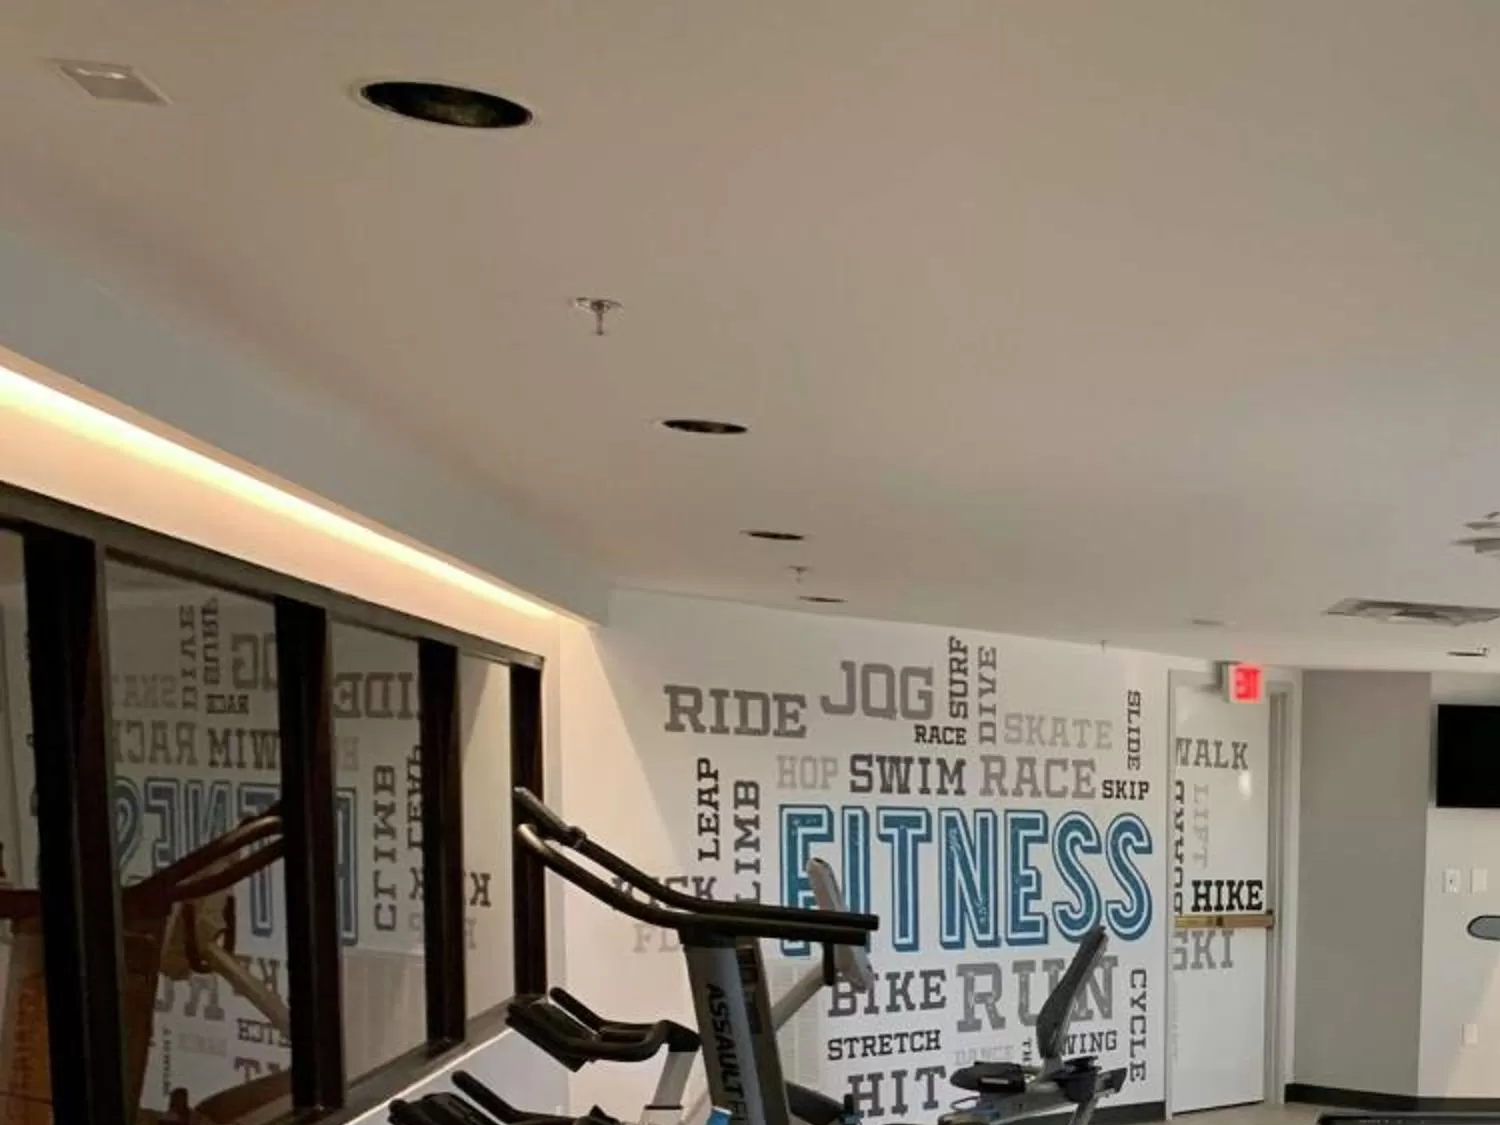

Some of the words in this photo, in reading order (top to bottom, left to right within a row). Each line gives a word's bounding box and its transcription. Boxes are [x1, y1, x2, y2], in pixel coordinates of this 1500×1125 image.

[820, 660, 933, 720] JOG
[948, 635, 968, 719] SURF
[978, 646, 996, 745] DIVE
[664, 684, 807, 738] RIDE
[914, 724, 966, 745] RACE
[1003, 712, 1113, 749] SKATE
[1127, 690, 1141, 771] SLIDE
[776, 755, 839, 790] HOP
[850, 753, 966, 796] SWIM
[979, 755, 1096, 799] RACE
[1102, 780, 1149, 800] SKIP
[697, 757, 720, 861] LEAP
[734, 779, 760, 905] LIMB
[779, 804, 1152, 956] FITNESS
[1191, 880, 1263, 912] HIKE
[828, 969, 947, 1018] BIKE
[956, 955, 1118, 1033] RUN
[827, 1030, 941, 1061] STRETCH
[1130, 968, 1147, 1083] CYCLE
